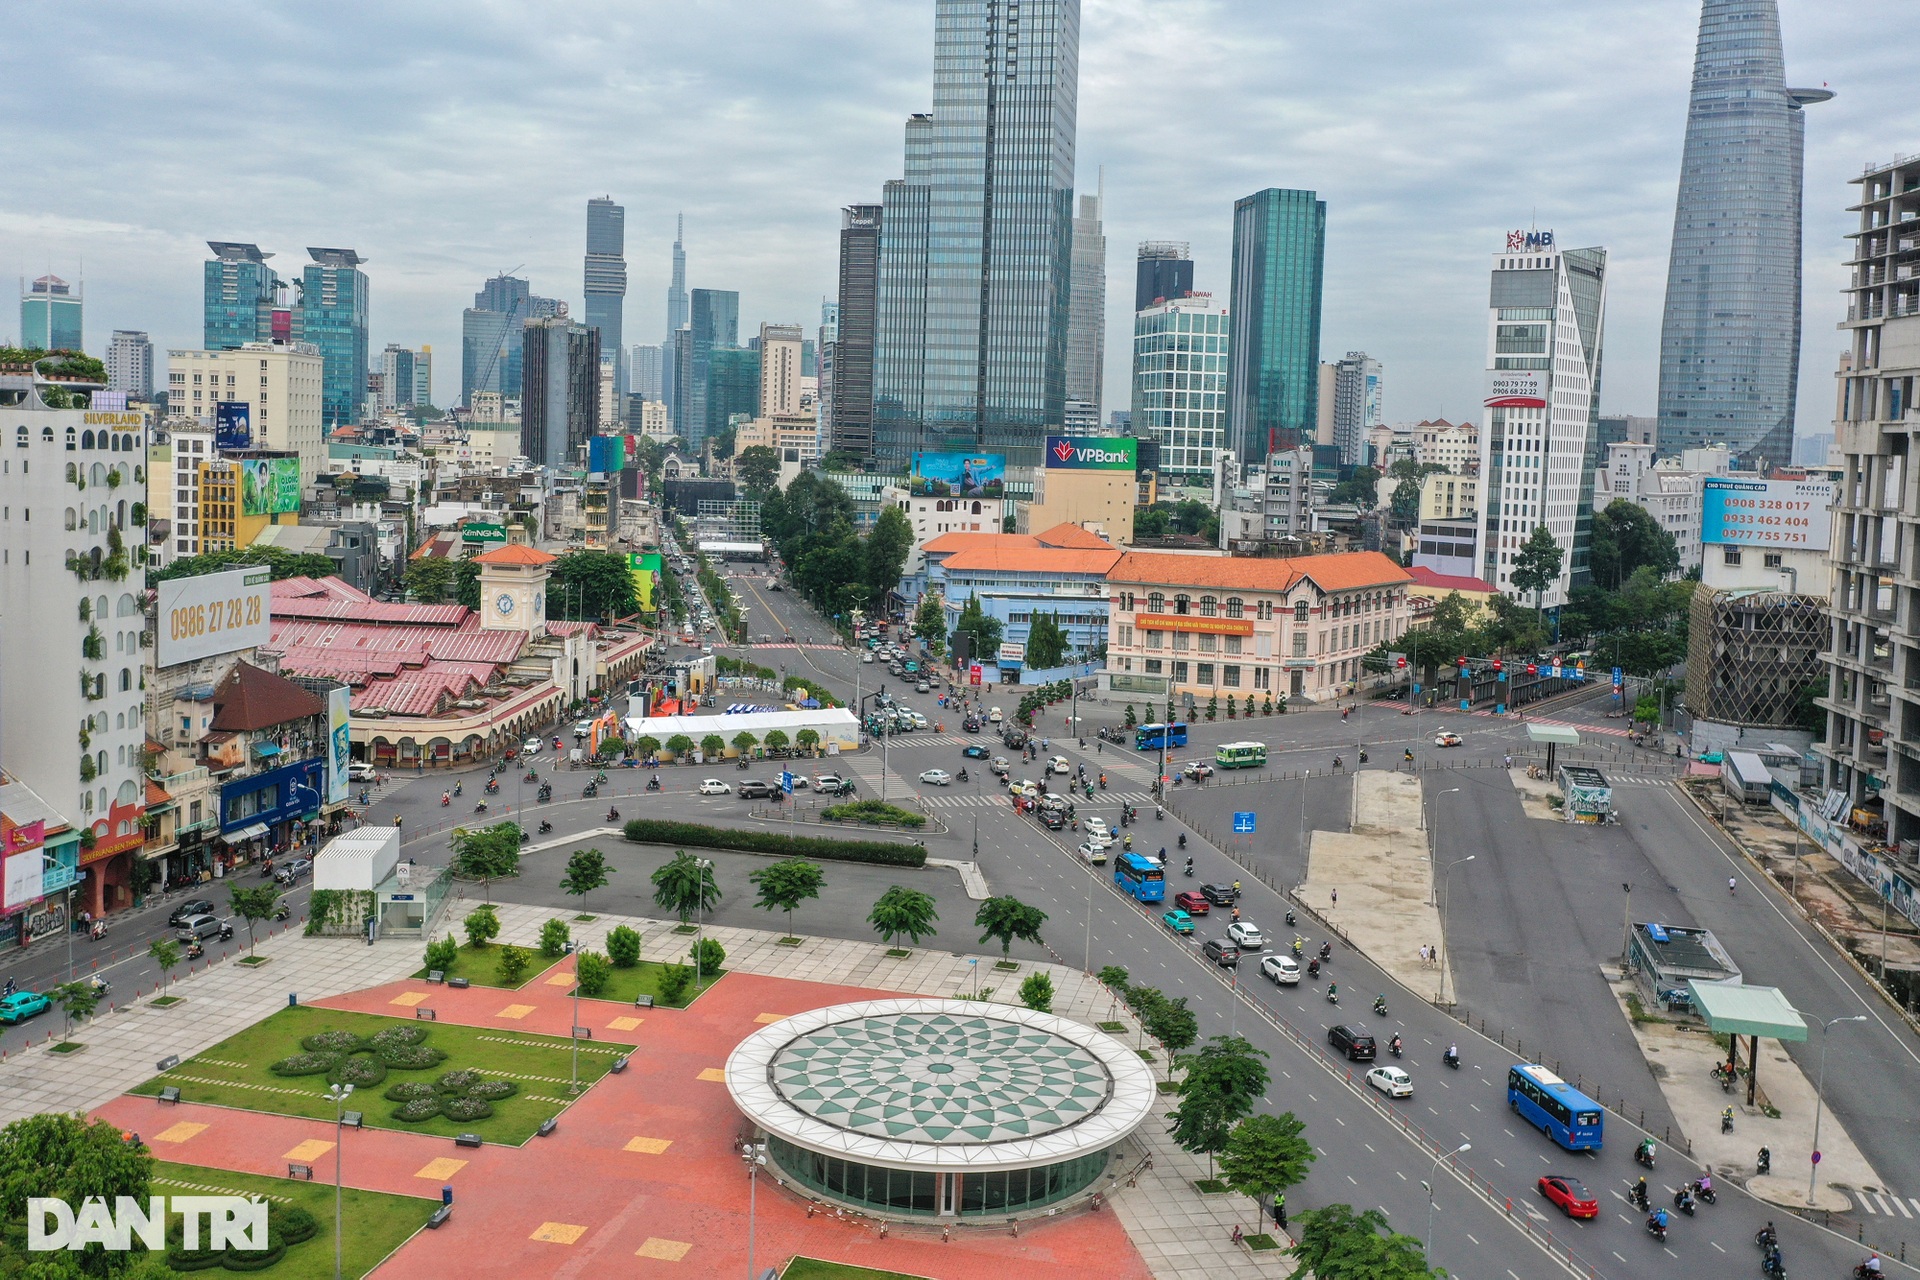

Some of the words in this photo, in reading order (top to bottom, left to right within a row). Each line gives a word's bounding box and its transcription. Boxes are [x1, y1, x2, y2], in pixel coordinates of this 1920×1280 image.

[1525, 232, 1552, 247] MB
[84, 412, 142, 425] SILVERLAND
[1076, 448, 1128, 463] VPBank
[1724, 498, 1755, 508] 0908
[1759, 500, 1782, 509] 328
[1786, 501, 1810, 510] 017
[1723, 514, 1754, 524] 0933
[1758, 515, 1780, 526] 462
[1785, 517, 1808, 527] 404
[1722, 529, 1753, 539] 0977
[1757, 531, 1780, 540] 755
[1784, 533, 1807, 542] 751
[171, 604, 204, 640] 0986
[209, 601, 224, 633] 27
[227, 598, 242, 629] 28
[246, 595, 260, 626] 28
[82, 847, 114, 862] SILVERLAND
